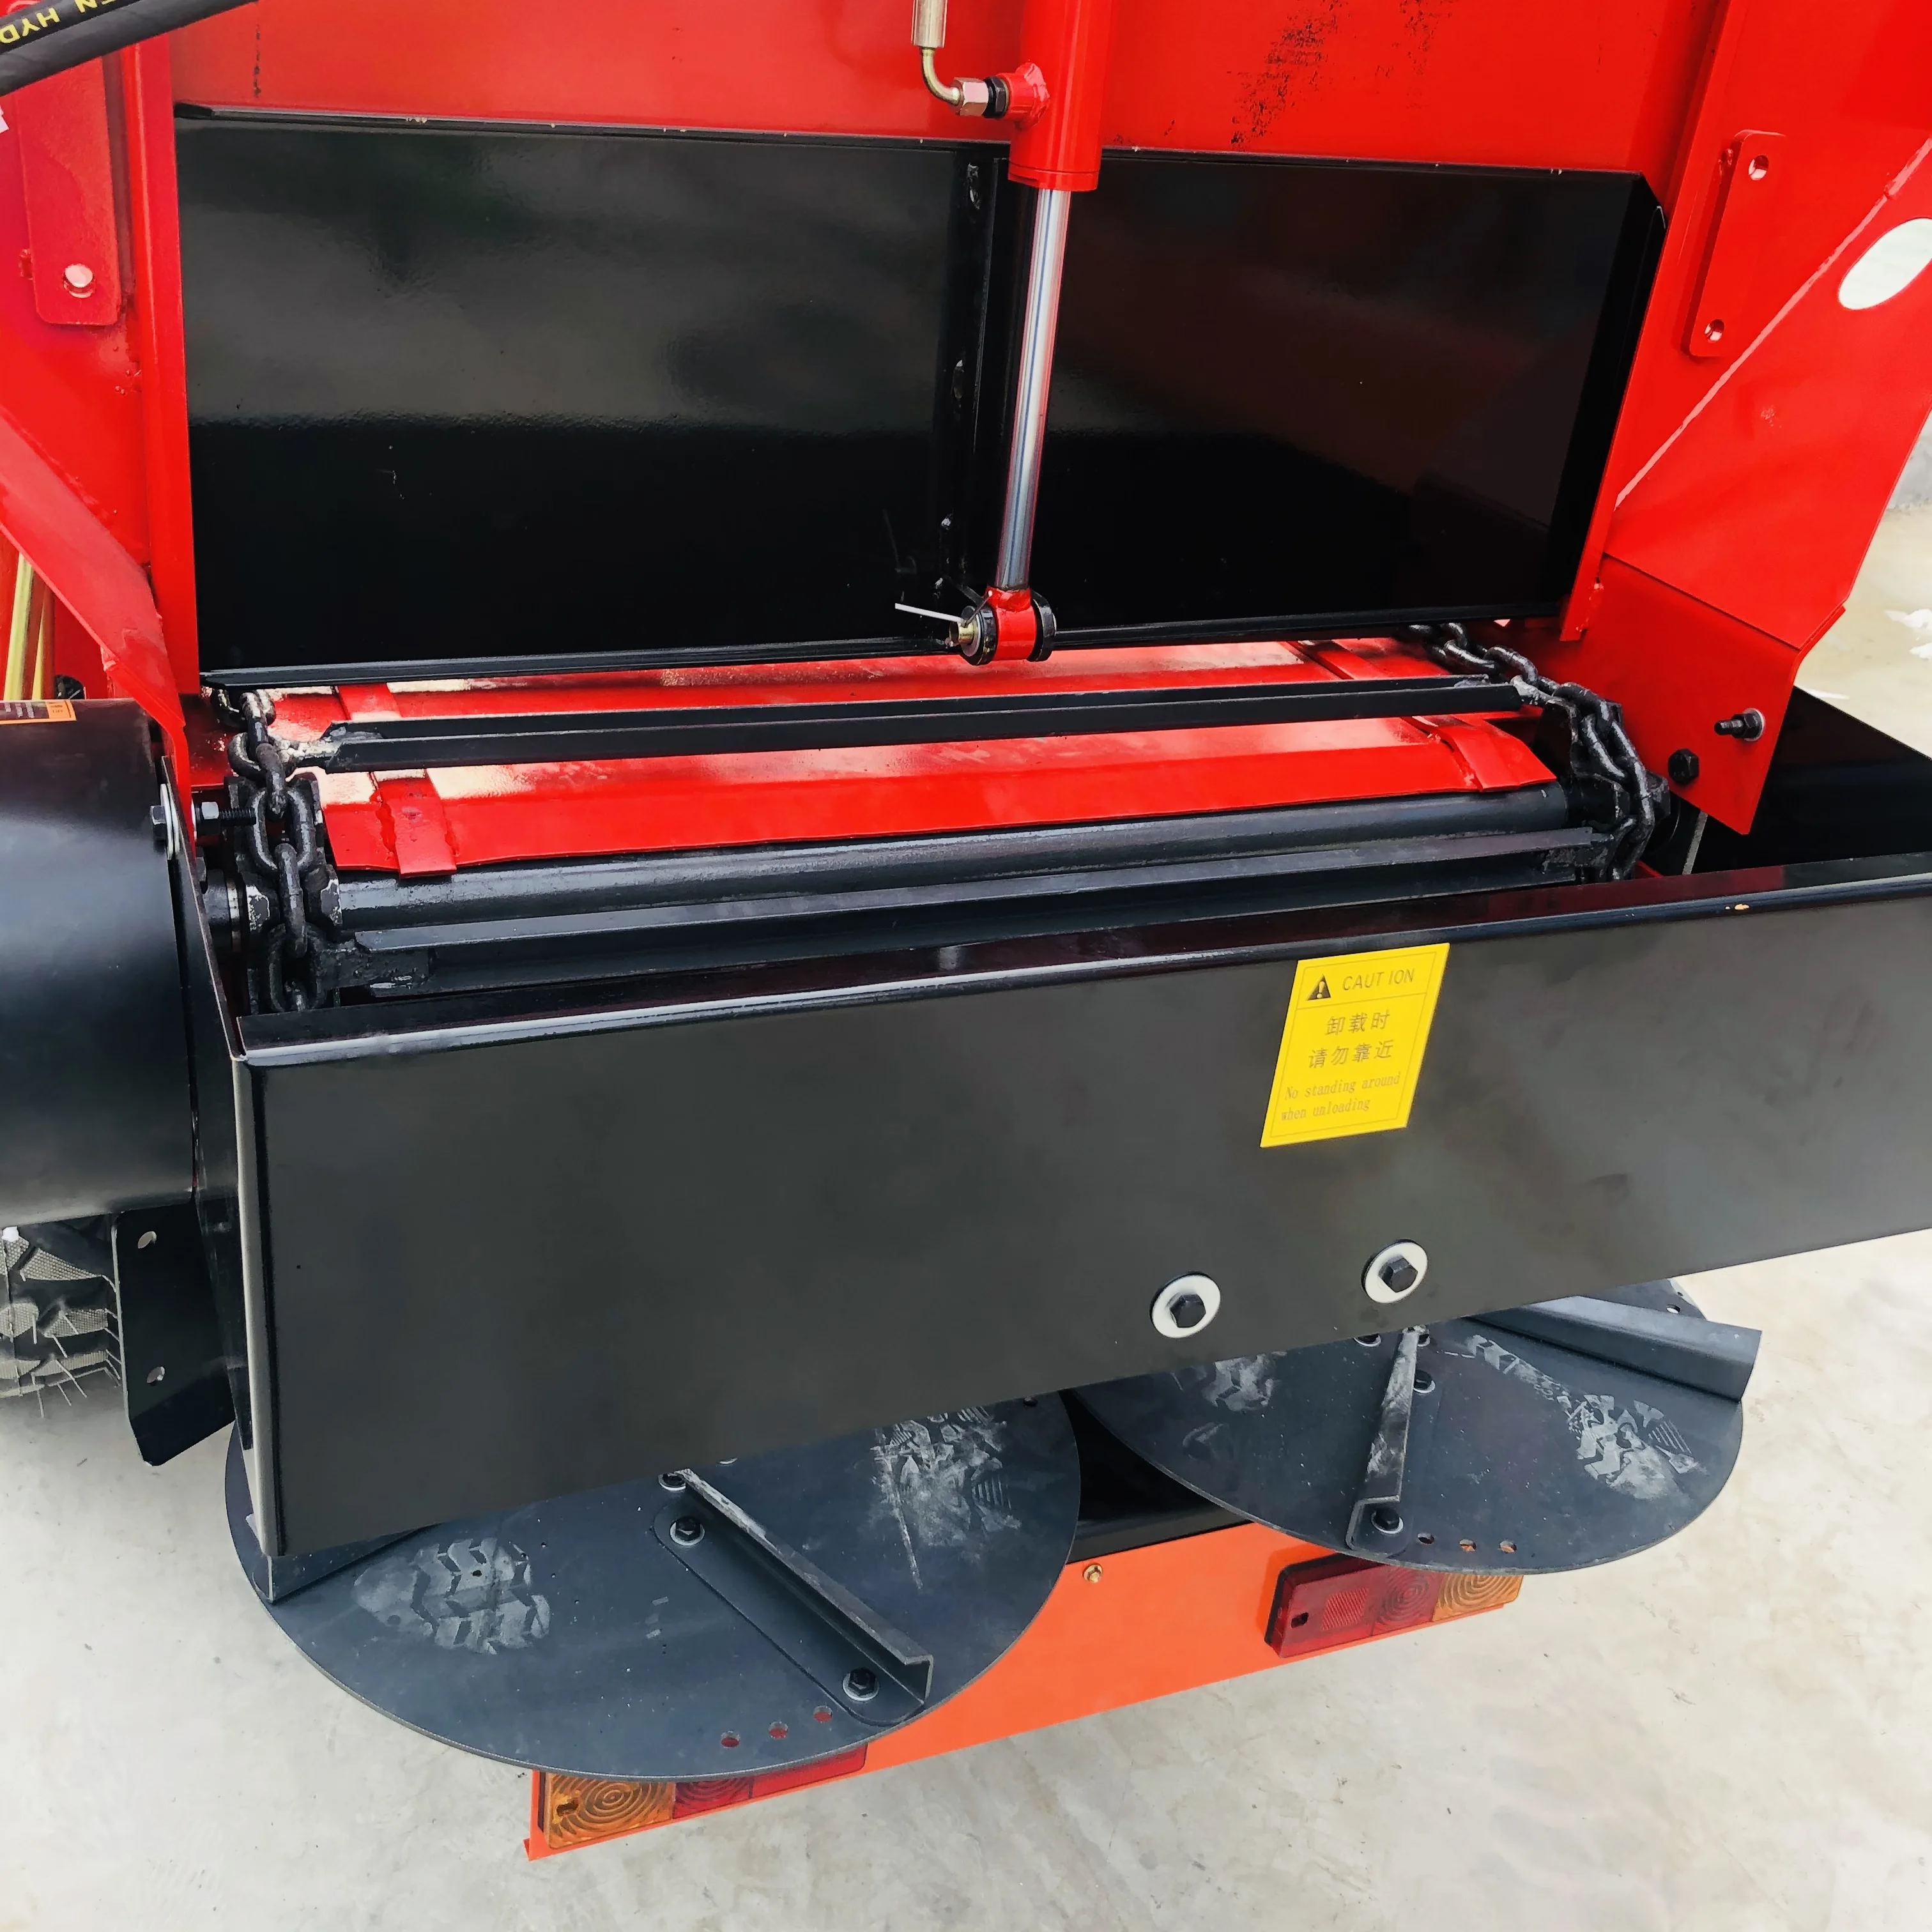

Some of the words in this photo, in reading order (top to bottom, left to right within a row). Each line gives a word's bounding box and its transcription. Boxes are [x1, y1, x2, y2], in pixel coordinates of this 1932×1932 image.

[1342, 968, 1414, 991] CAUTION
[1324, 1009, 1390, 1036] 卸载时
[1308, 1039, 1394, 1069] 请勿靠近
[1284, 1087, 1298, 1100] No
[1305, 1080, 1356, 1097] standing
[1361, 1071, 1401, 1089] around
[1280, 1106, 1307, 1121] when
[1313, 1098, 1371, 1115] unloading
